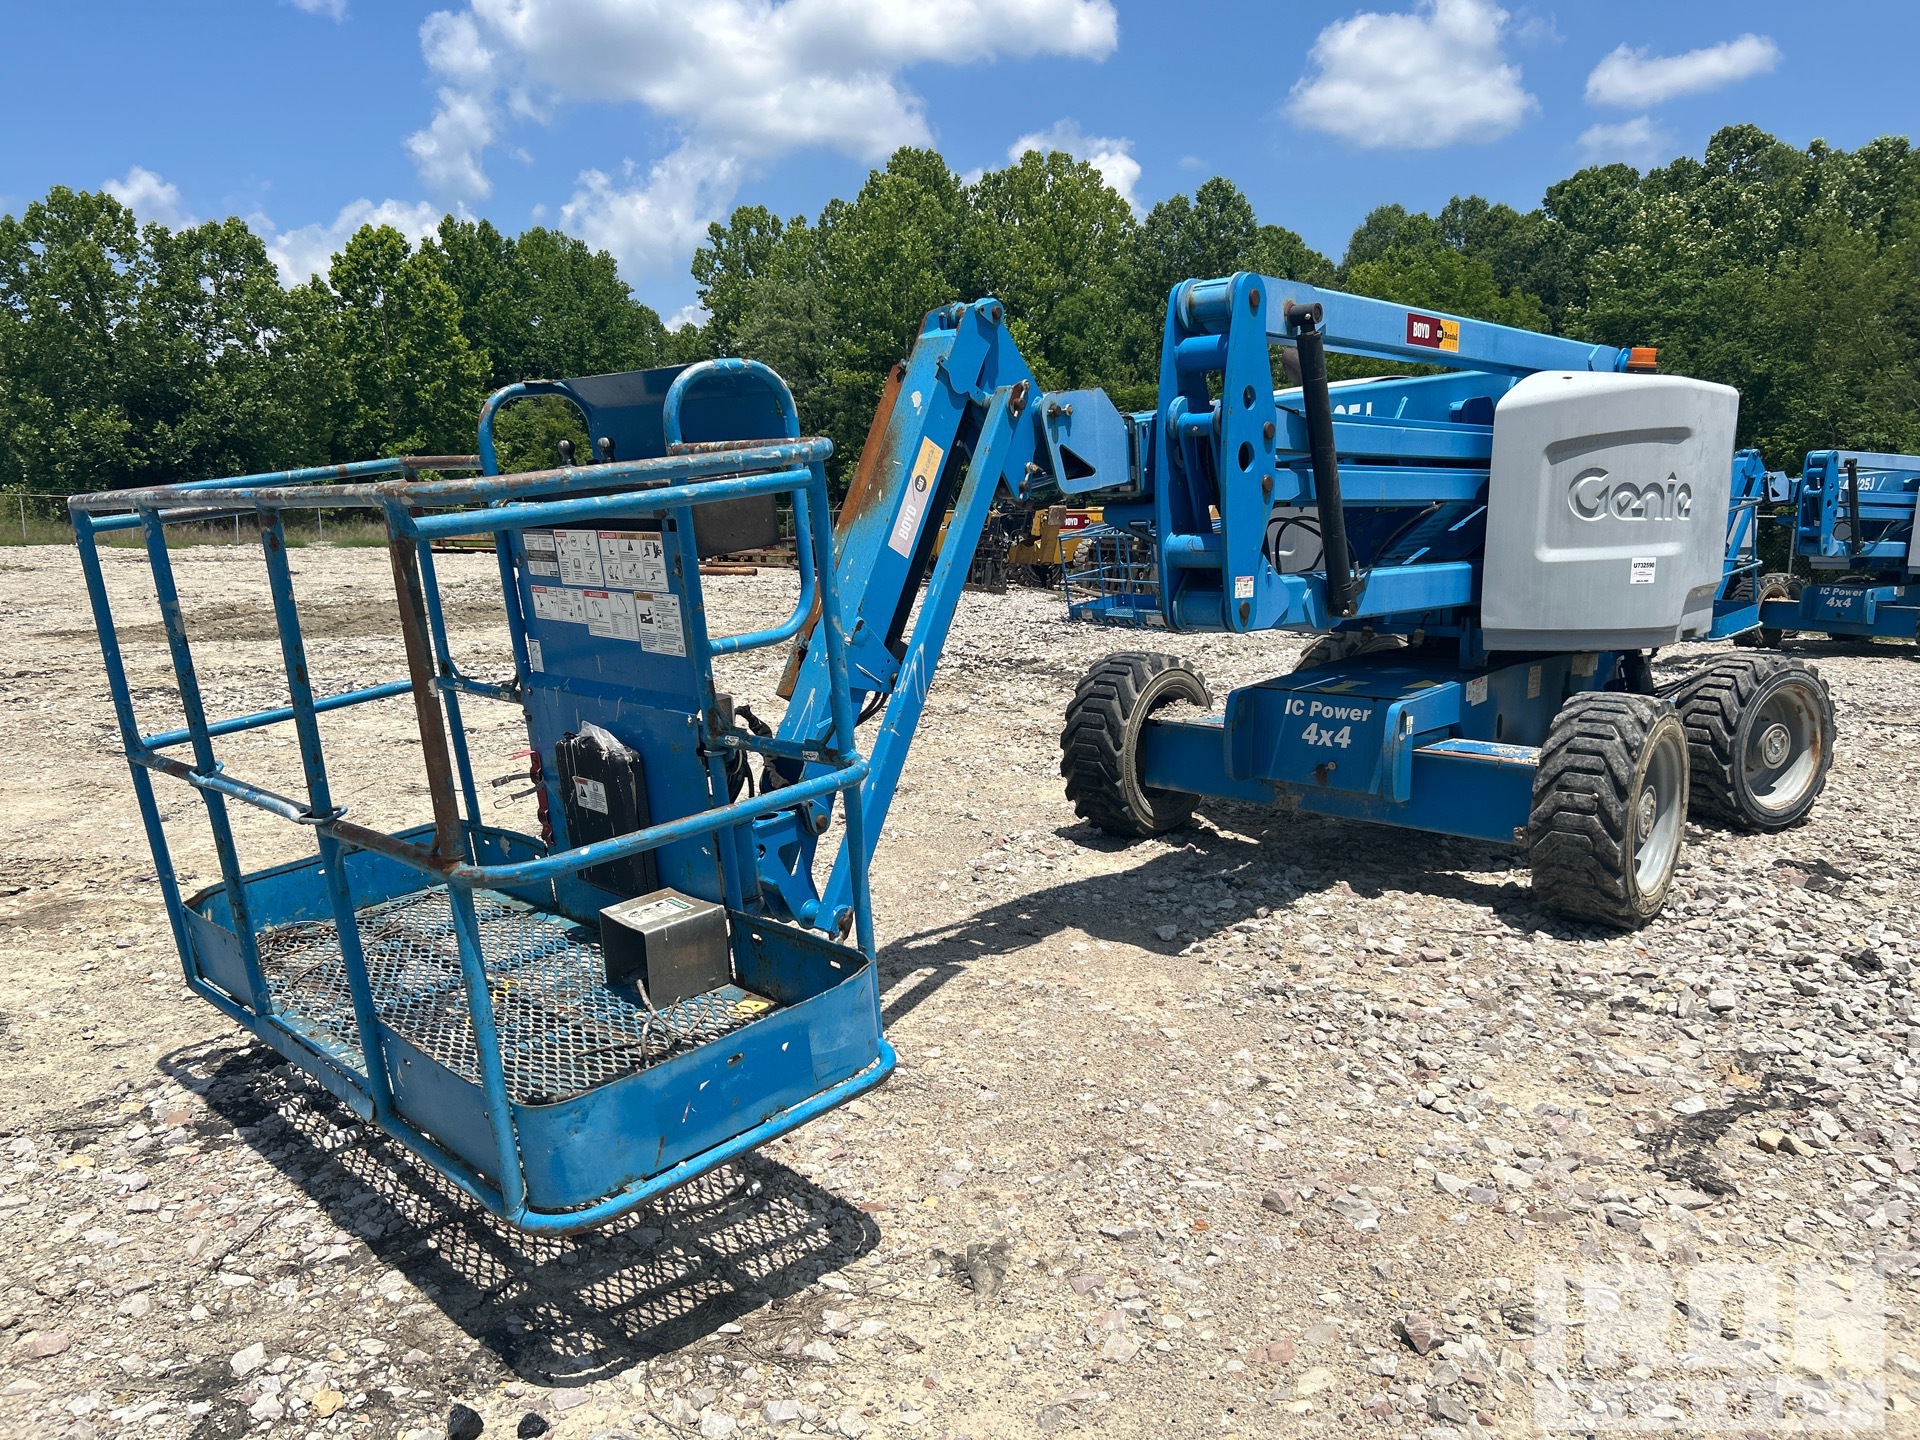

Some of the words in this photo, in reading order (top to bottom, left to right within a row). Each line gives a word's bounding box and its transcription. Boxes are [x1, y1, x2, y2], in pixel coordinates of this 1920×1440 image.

[1413, 322, 1430, 339] BOYD
[916, 477, 926, 491] CAT
[1567, 467, 1692, 521] Genie
[898, 504, 917, 541] BOYD
[1819, 587, 1830, 595] IC
[1832, 588, 1864, 597] Power
[1826, 597, 1852, 608] 4x4
[1284, 699, 1305, 716] IC
[1309, 701, 1372, 722] Power
[1301, 722, 1352, 749] 4x4
